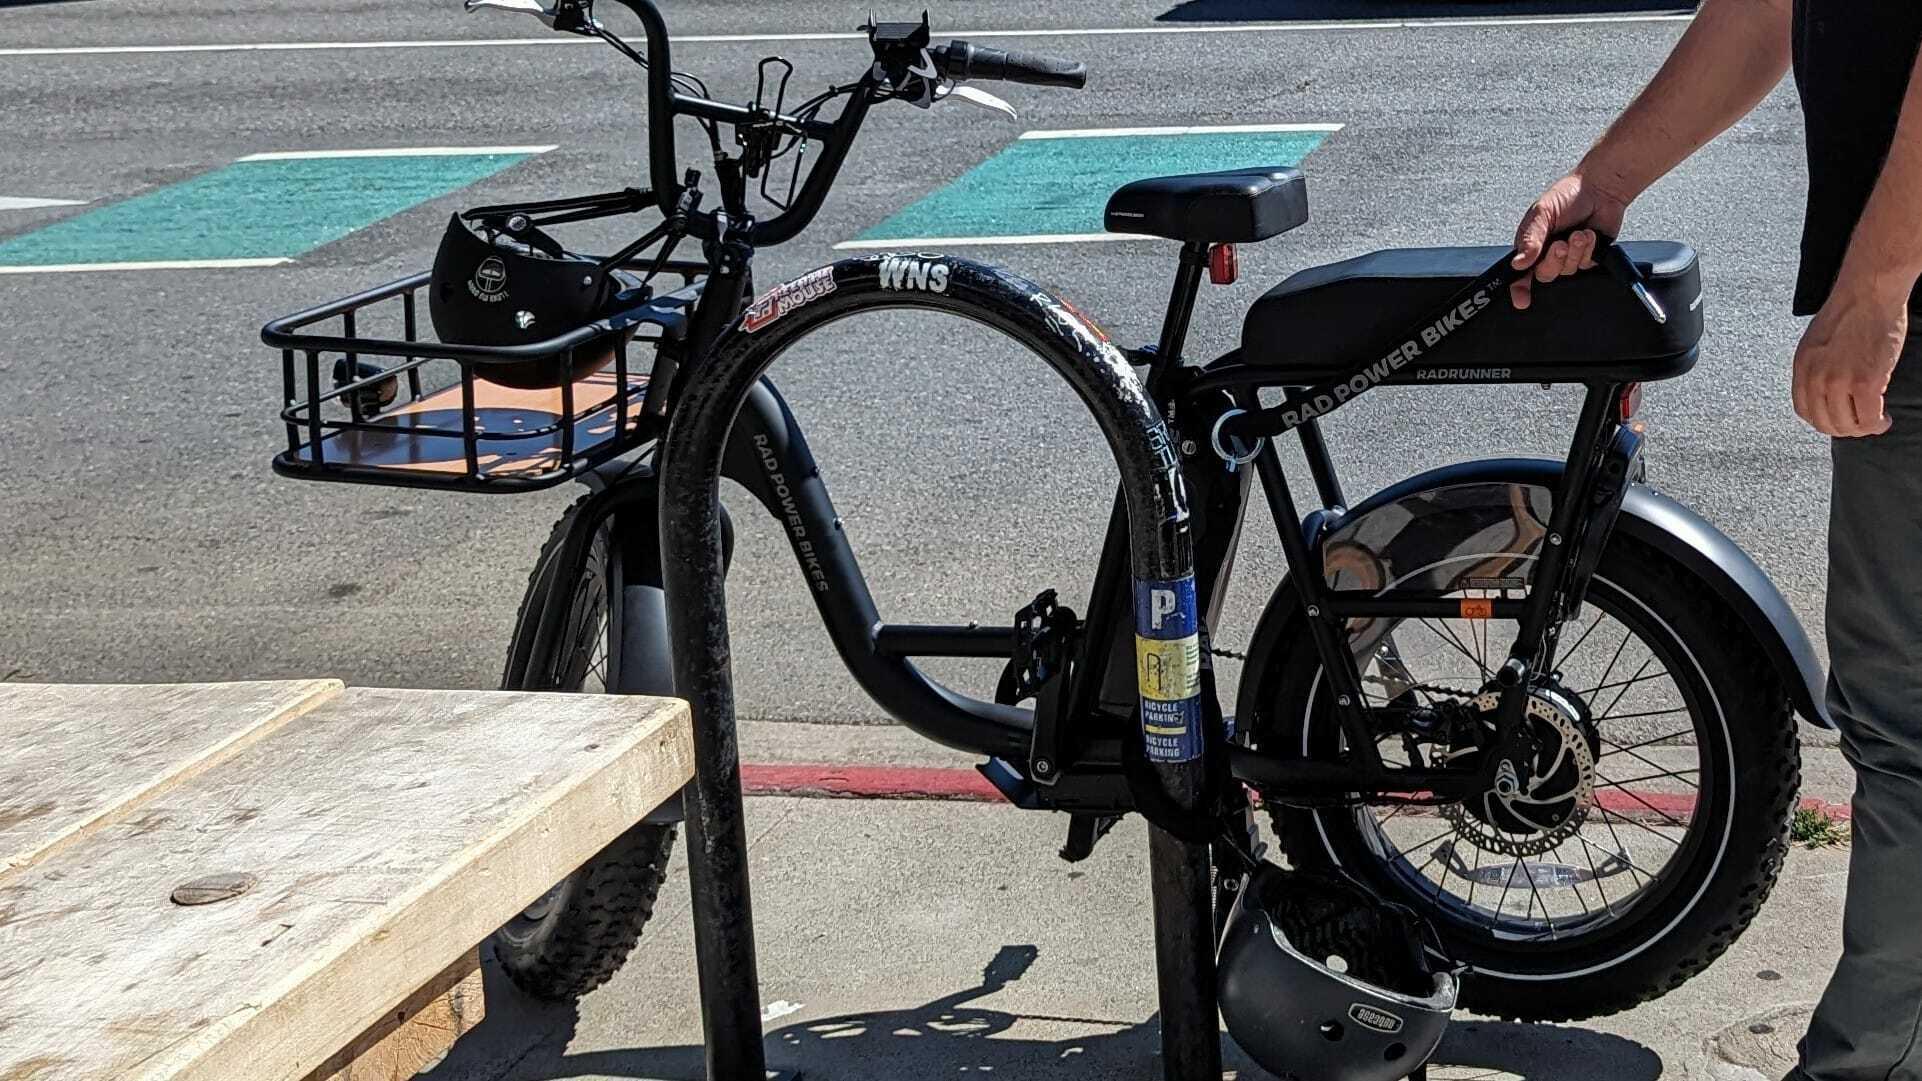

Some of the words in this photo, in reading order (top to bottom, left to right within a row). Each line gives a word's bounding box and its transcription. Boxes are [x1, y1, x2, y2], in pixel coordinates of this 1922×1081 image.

[879, 258, 950, 294] WNS
[778, 281, 836, 315] MOUSE
[1282, 390, 1336, 430] RAD
[1335, 340, 1422, 404] POWER
[1416, 367, 1512, 380] RADRUNNER
[753, 434, 778, 473] RAD
[770, 473, 806, 537] POWER
[799, 540, 829, 592] BIKES
[1151, 588, 1177, 630] P
[1146, 744, 1181, 758] PARKING
